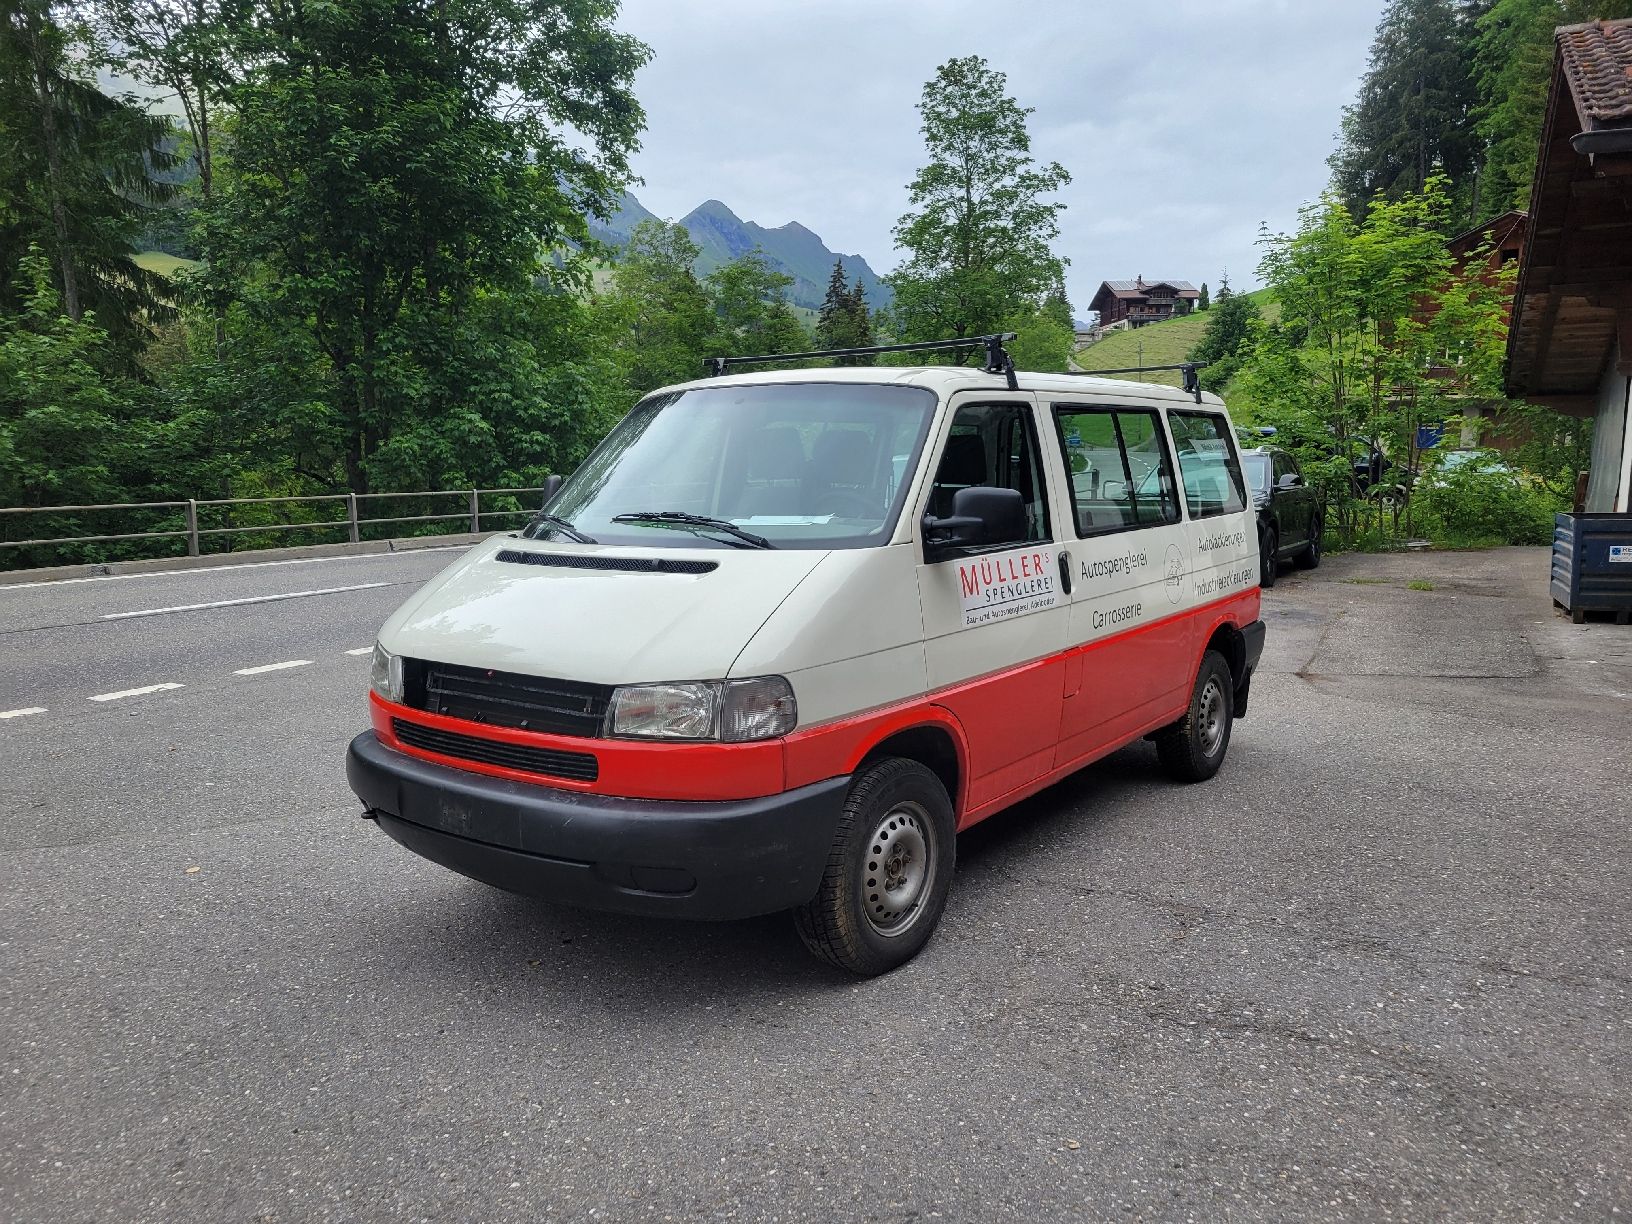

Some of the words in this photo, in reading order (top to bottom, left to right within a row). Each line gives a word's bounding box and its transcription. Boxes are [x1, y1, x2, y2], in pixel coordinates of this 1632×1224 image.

[1081, 547, 1148, 580] Autospenglerei
[985, 575, 1054, 603] SPENGLEREI
[1092, 602, 1142, 630] Carrosserie
